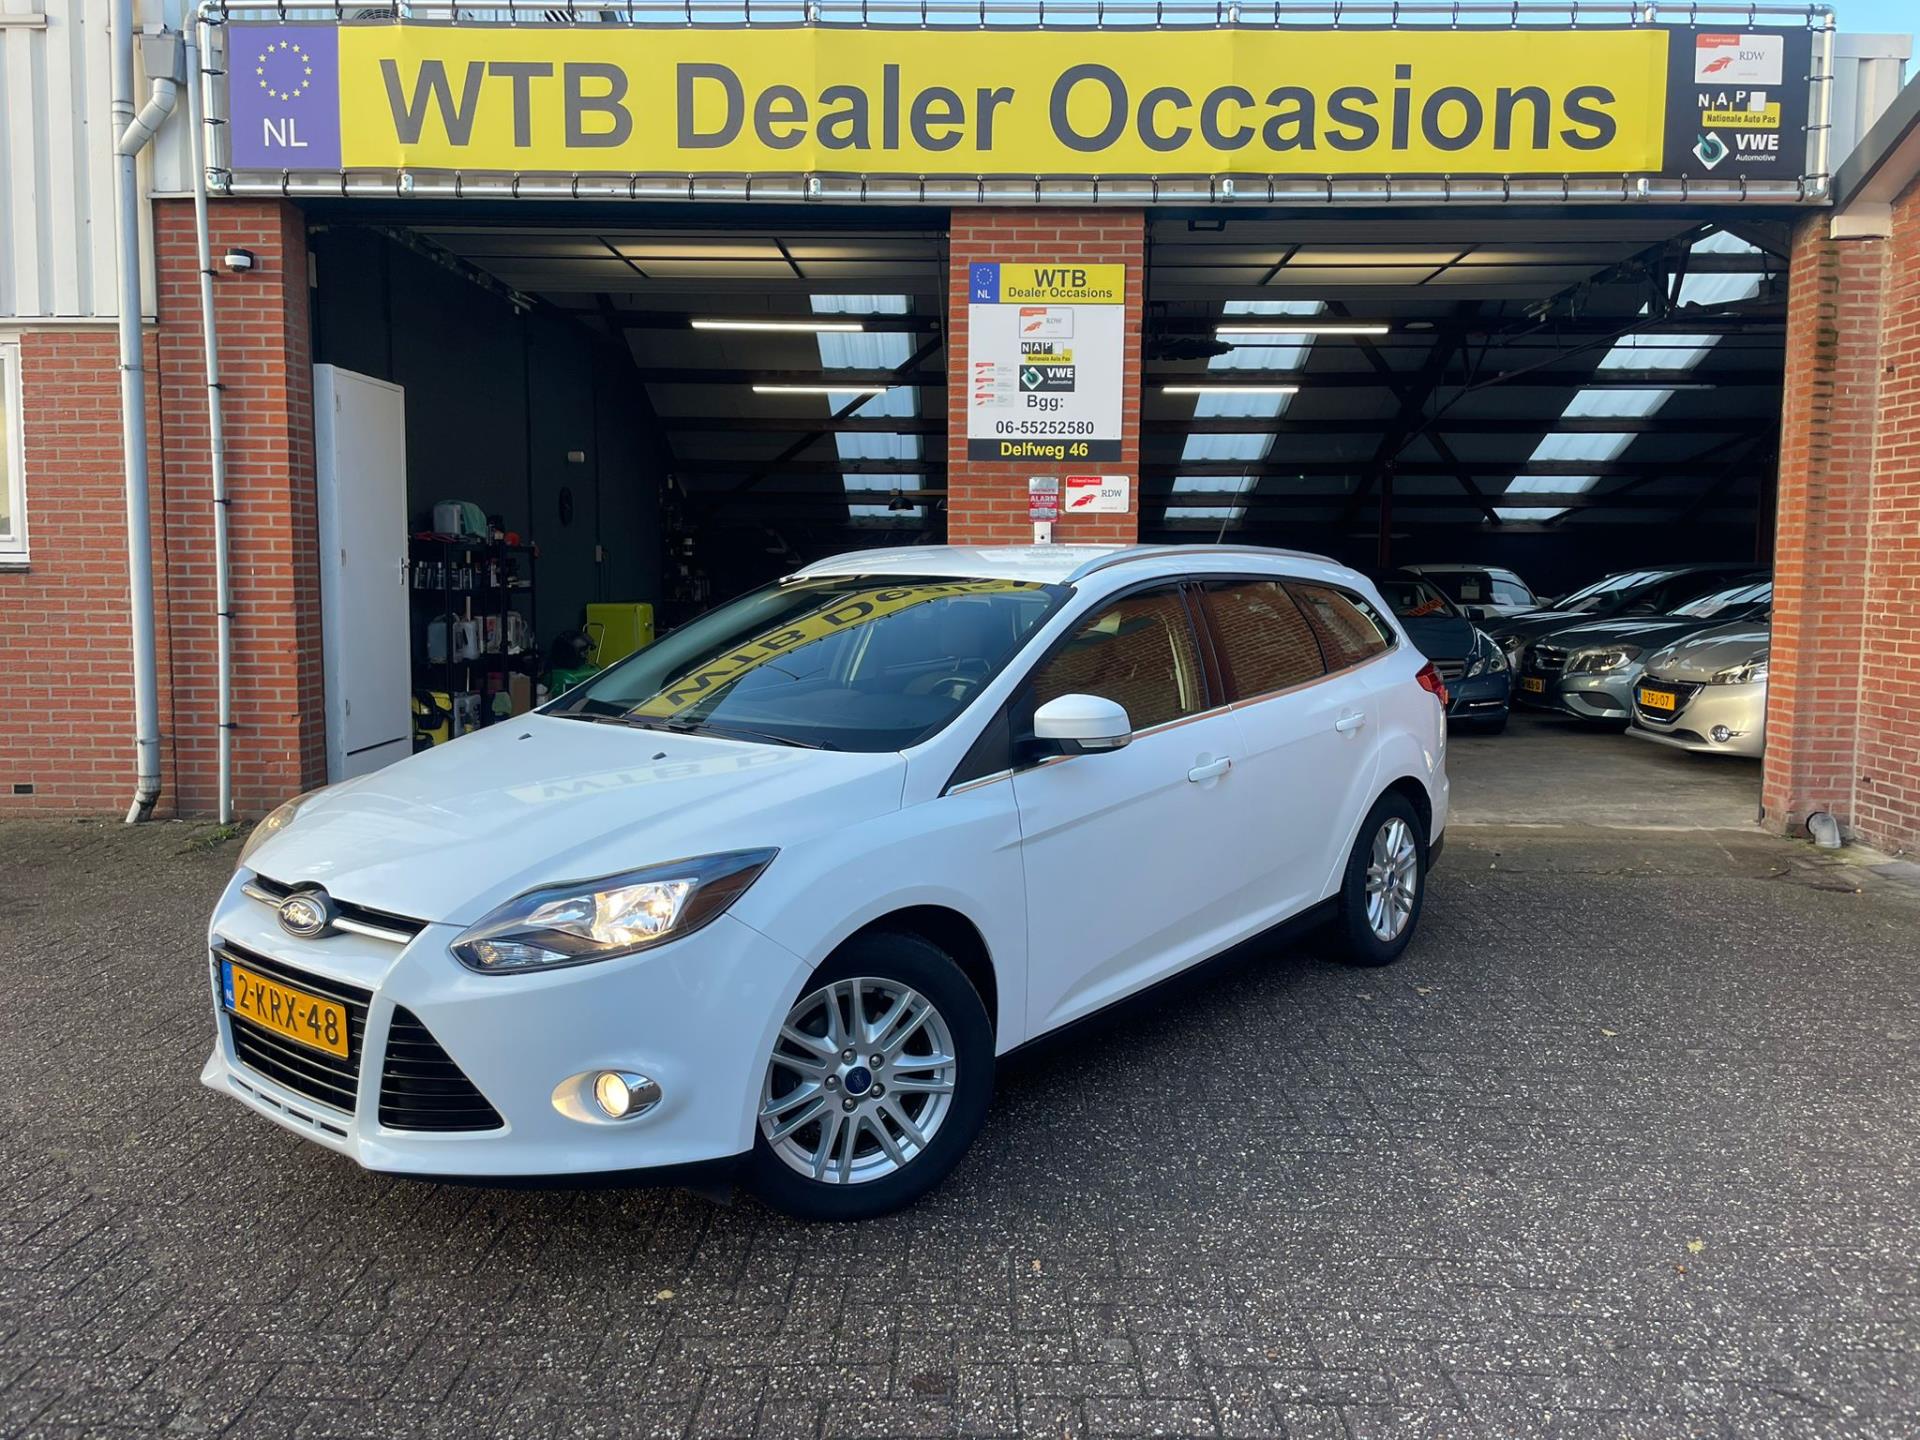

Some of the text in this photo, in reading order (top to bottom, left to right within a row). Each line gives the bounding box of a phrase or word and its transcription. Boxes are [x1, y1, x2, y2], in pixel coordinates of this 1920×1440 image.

[1738, 51, 1765, 61] RDW
[380, 59, 1618, 152] WTB Dealer Occasions
[1706, 114, 1776, 123] Nationale Auto Pas
[263, 118, 308, 148] NL
[1735, 133, 1779, 150] VWE
[1735, 153, 1777, 162] Automotive
[1034, 269, 1087, 288] WTB
[977, 289, 991, 299] NL
[1008, 286, 1113, 298] Dealer Occasions
[1046, 367, 1074, 378] VWE
[1027, 394, 1064, 411] Bgg:
[995, 420, 1095, 435] 06-55252580
[1000, 441, 1089, 460] Delfweg 46
[1030, 495, 1057, 503] ALARM
[1101, 489, 1122, 498] RDW
[238, 974, 339, 1046] 2-KRX-48
